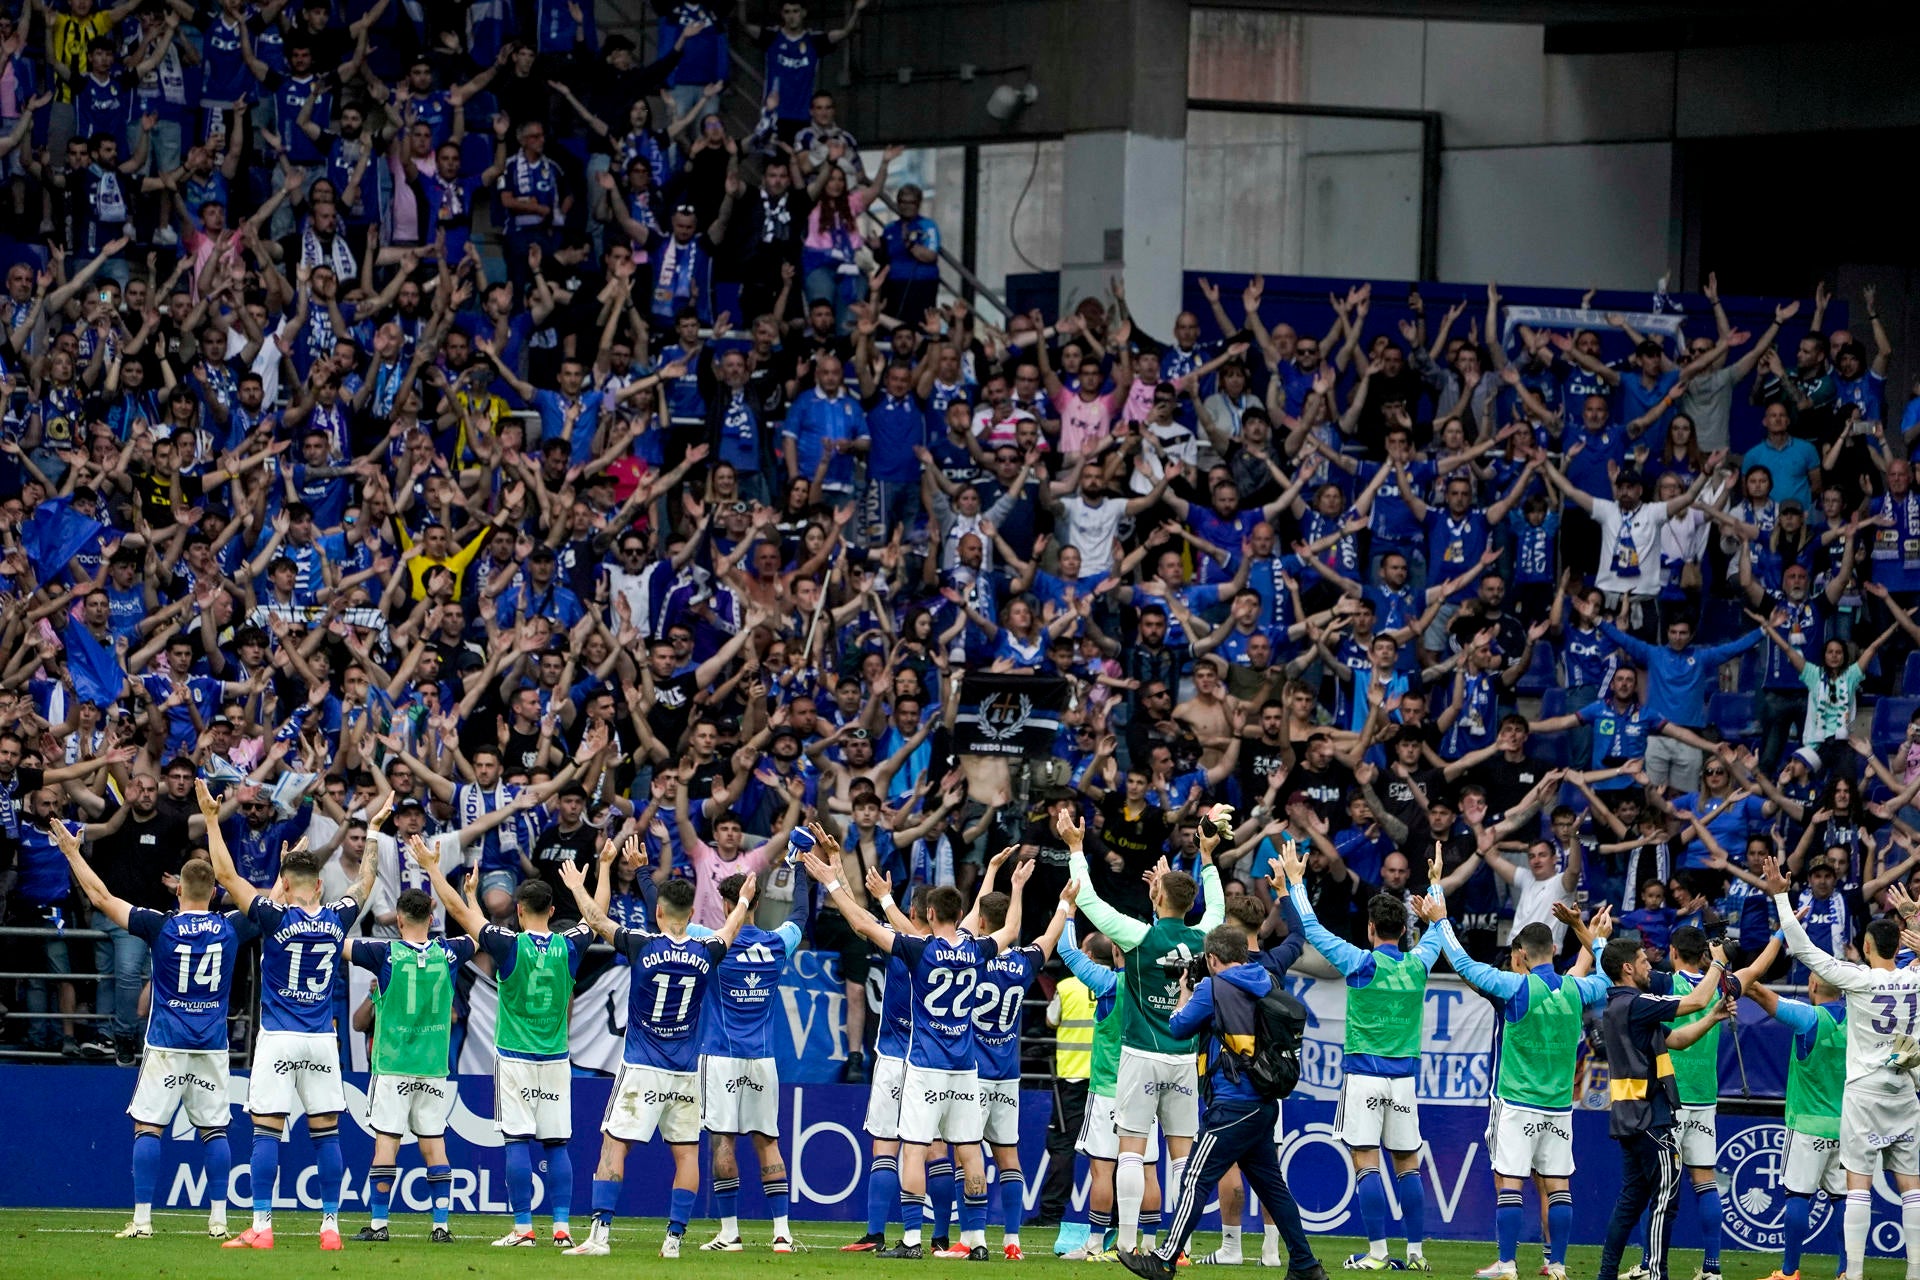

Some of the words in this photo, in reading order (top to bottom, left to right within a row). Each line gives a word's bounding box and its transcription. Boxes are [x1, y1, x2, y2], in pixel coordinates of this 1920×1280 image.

[970, 742, 1001, 752] OVIEDO
[274, 920, 344, 944] HOMENCHENKO
[174, 943, 223, 993] 14
[284, 943, 337, 992] 13
[642, 950, 710, 975] COLOMBATTO
[987, 960, 1023, 976] MASCA
[181, 1000, 219, 1010] HYUNDAI
[402, 963, 446, 1014] 17
[526, 967, 555, 1013] 5
[651, 973, 697, 1022] 11
[730, 989, 747, 997] CAJA
[749, 989, 770, 997] RURAL
[924, 967, 978, 1018] 22
[971, 982, 1025, 1033] 20
[1148, 995, 1166, 1004] CAJA
[1870, 993, 1918, 1036] 31
[179, 1073, 216, 1092] DXTOOLS
[1728, 1129, 1786, 1162] OVIE
[1720, 1197, 1752, 1240] RIGEN
